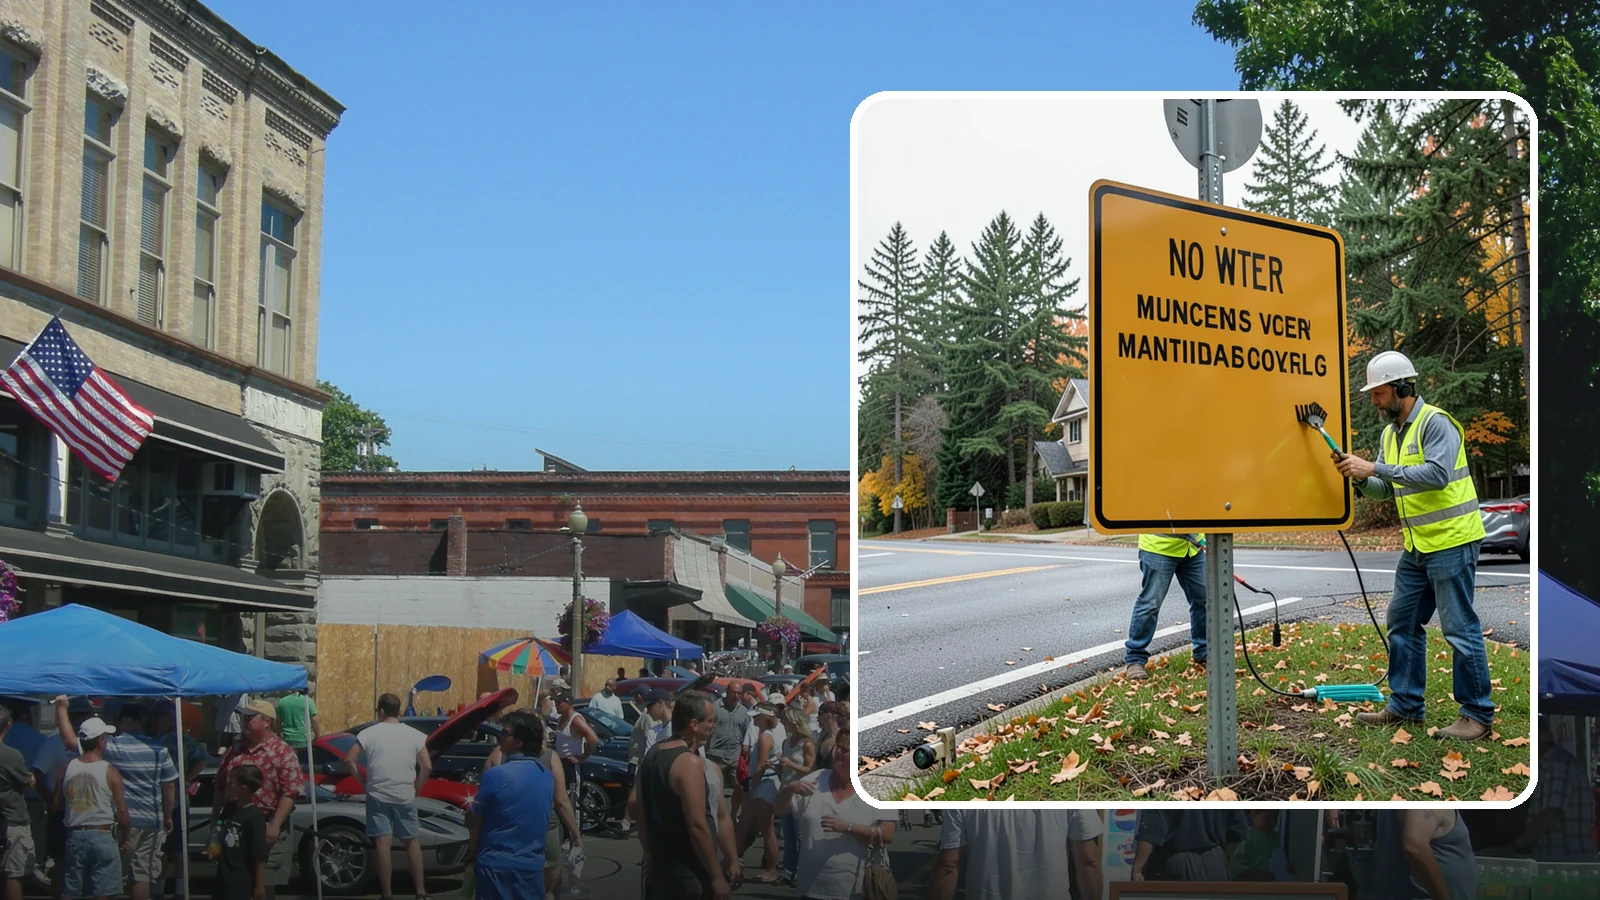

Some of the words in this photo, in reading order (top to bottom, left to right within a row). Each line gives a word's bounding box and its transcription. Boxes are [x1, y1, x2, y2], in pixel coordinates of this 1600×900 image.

[1168, 237, 1205, 281] NO
[1214, 244, 1284, 295] WTER
[1136, 293, 1252, 333] MUNCENS
